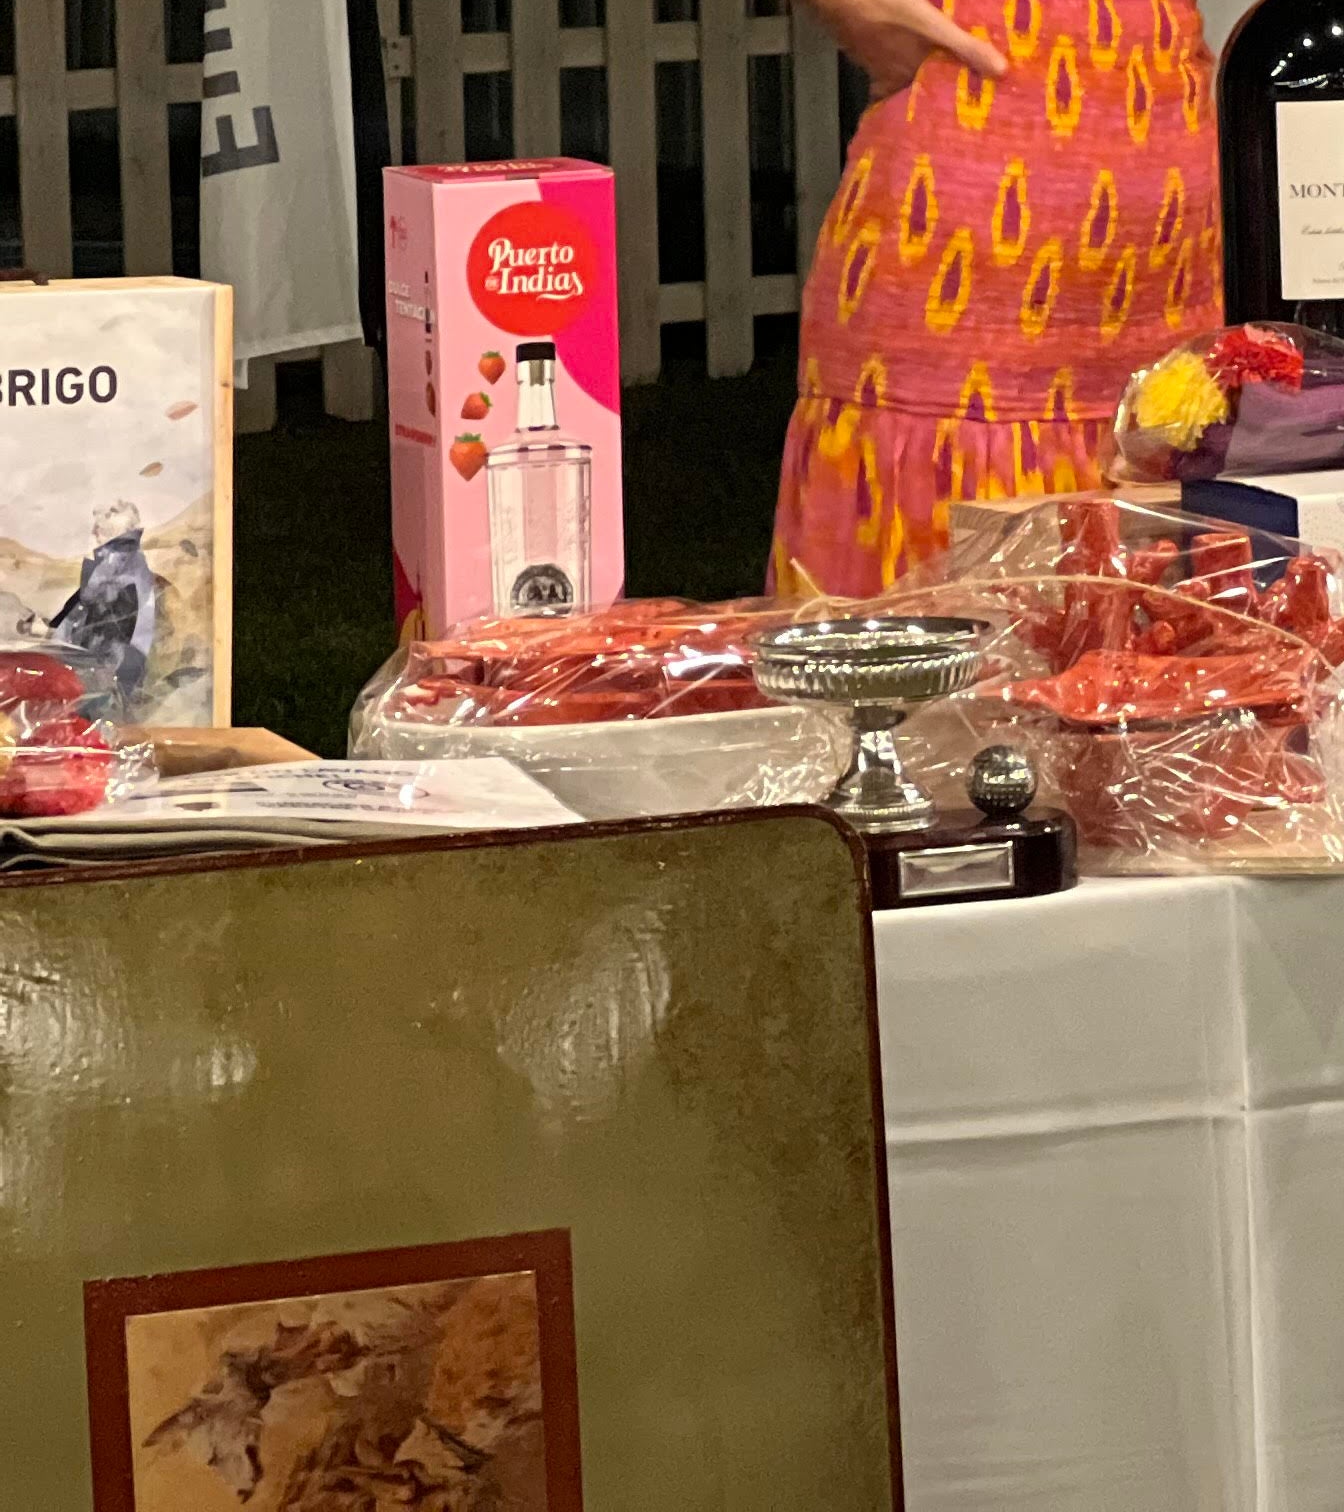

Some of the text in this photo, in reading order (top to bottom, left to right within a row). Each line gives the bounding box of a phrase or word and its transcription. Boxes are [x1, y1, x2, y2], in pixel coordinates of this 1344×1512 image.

[487, 236, 575, 275] Puerto
[497, 266, 585, 302] Indias
[0, 365, 118, 407] RIGO
